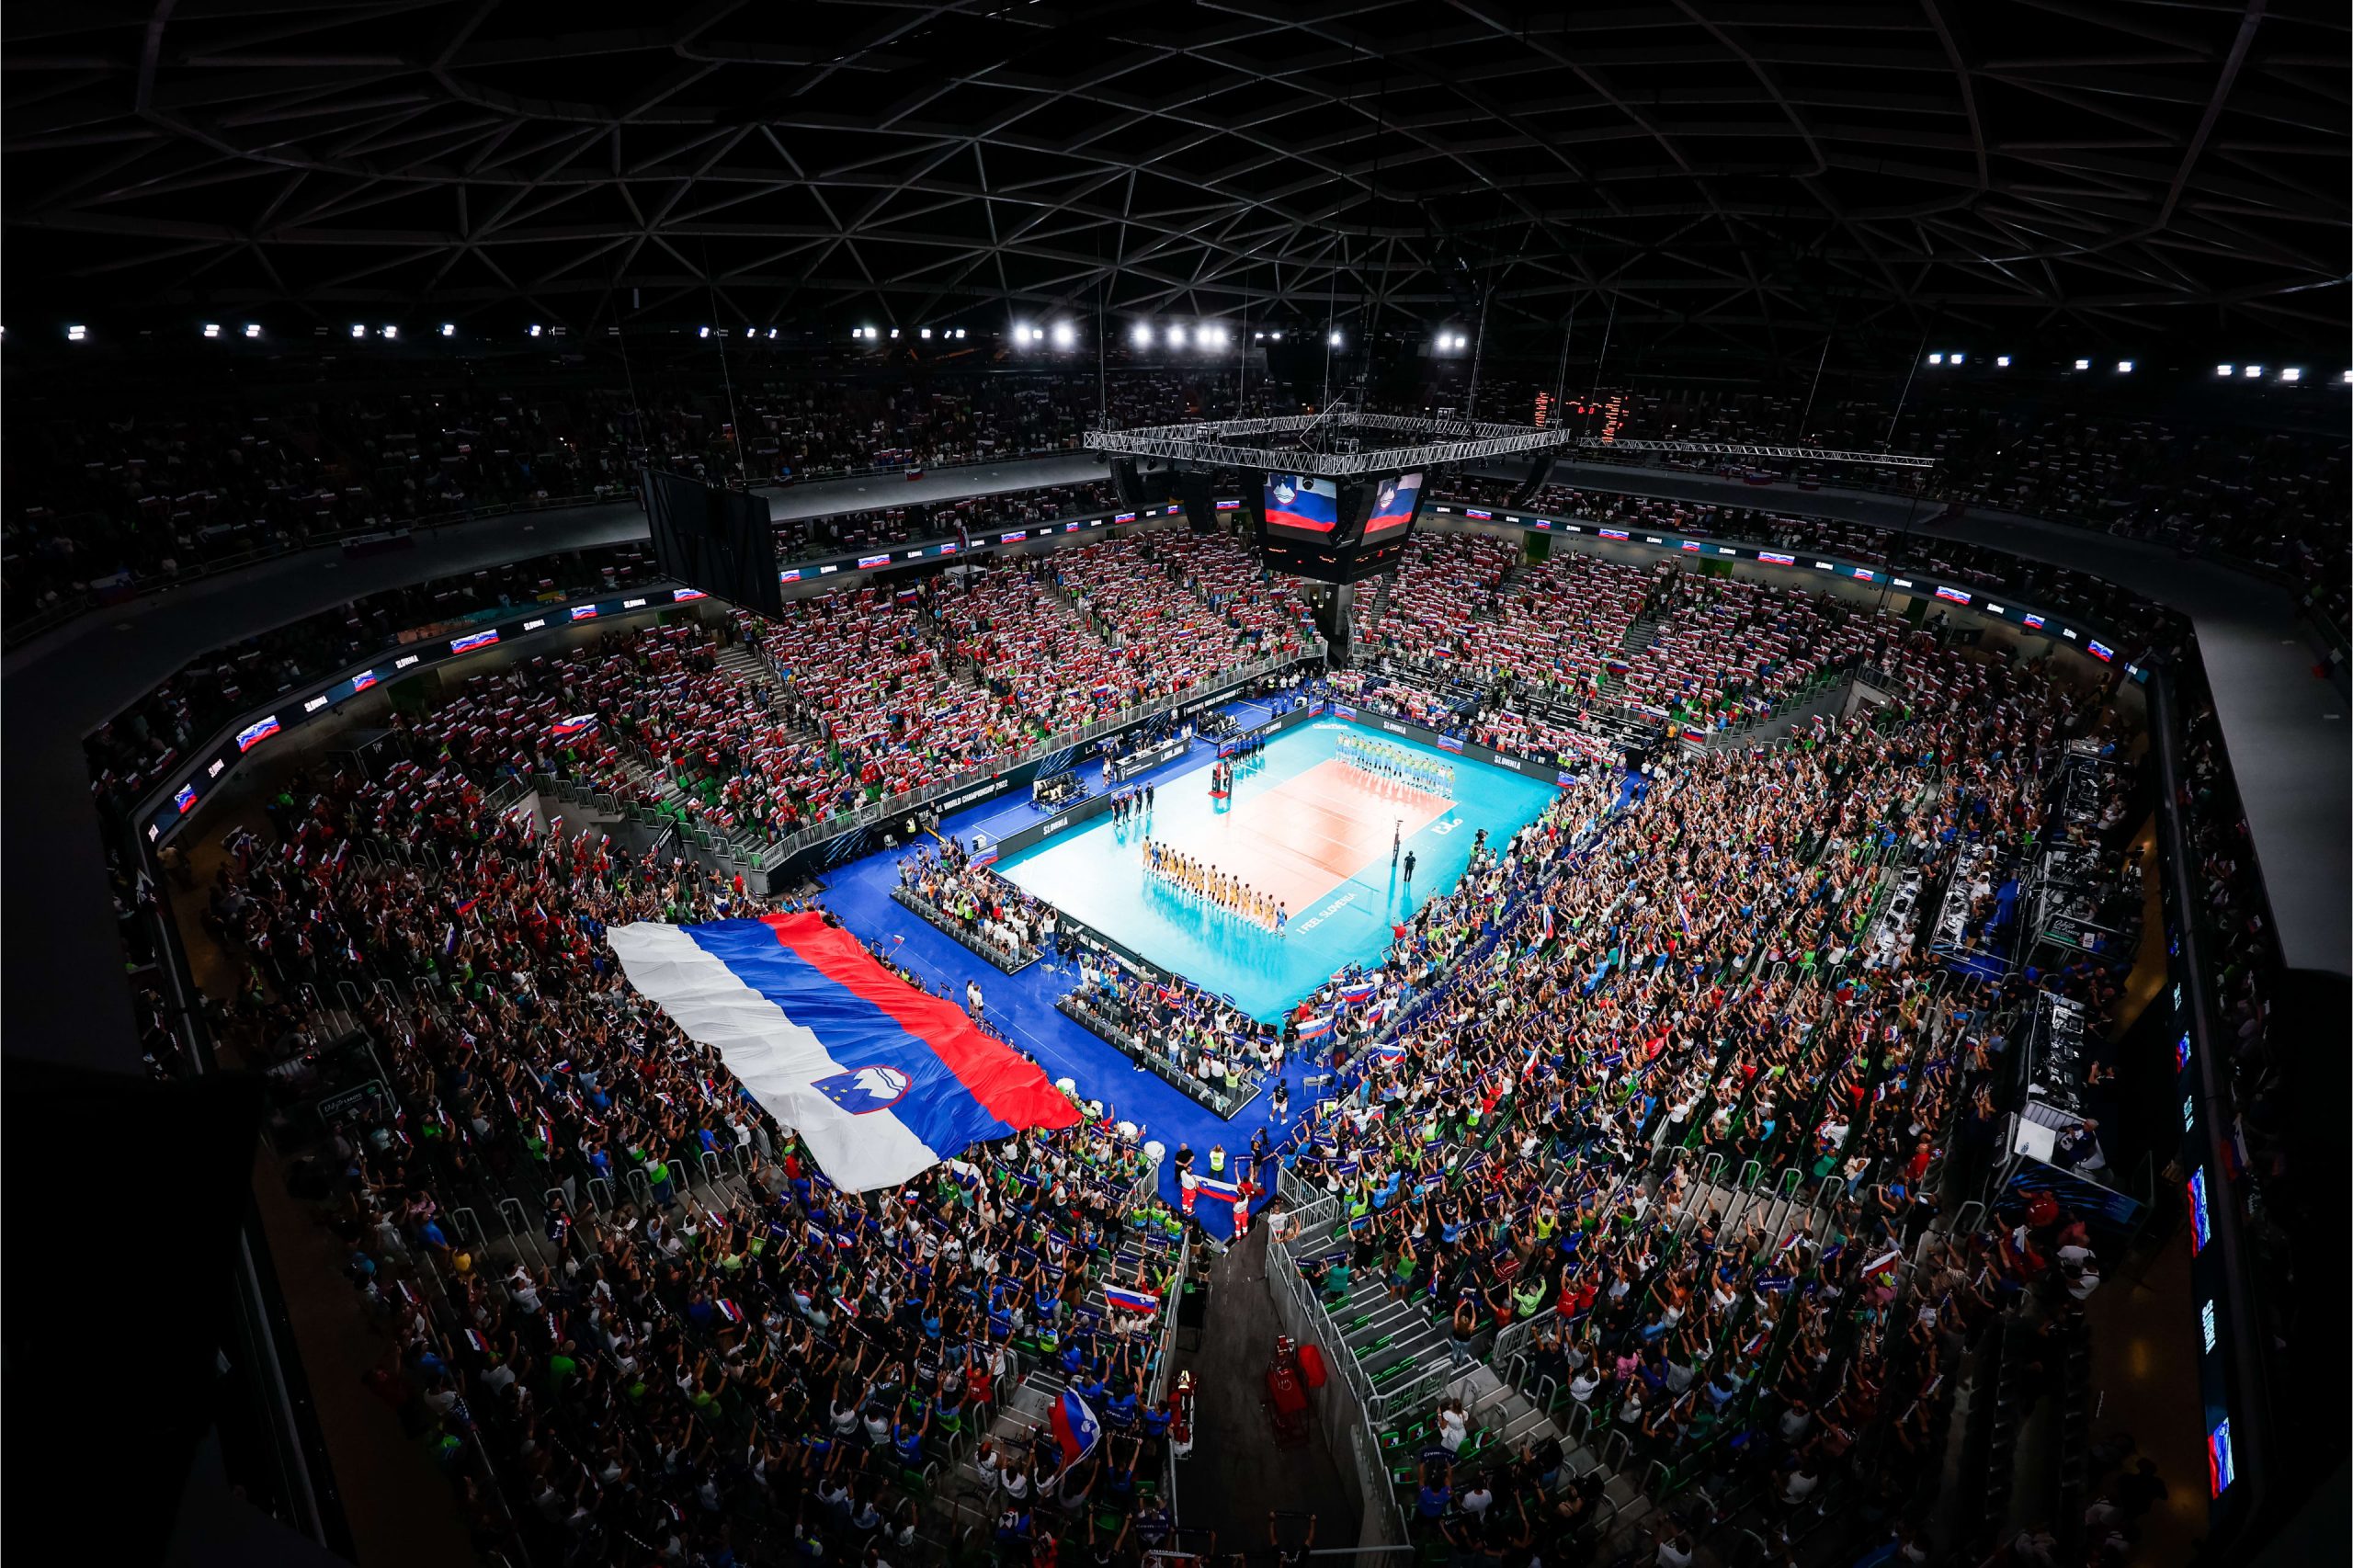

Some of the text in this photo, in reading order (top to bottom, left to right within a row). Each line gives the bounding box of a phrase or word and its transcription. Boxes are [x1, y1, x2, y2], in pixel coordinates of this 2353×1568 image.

[1382, 721, 1406, 735] SLOVENIA
[1494, 755, 1521, 771] SLOVENIA
[943, 797, 961, 811] WORLD
[961, 784, 995, 804] CHAMPIONSHIP
[995, 779, 1008, 790] 2022
[1043, 816, 1068, 835] SLOVENIA
[1301, 917, 1324, 932] FEEL
[1318, 892, 1358, 919] SLOVENIA
